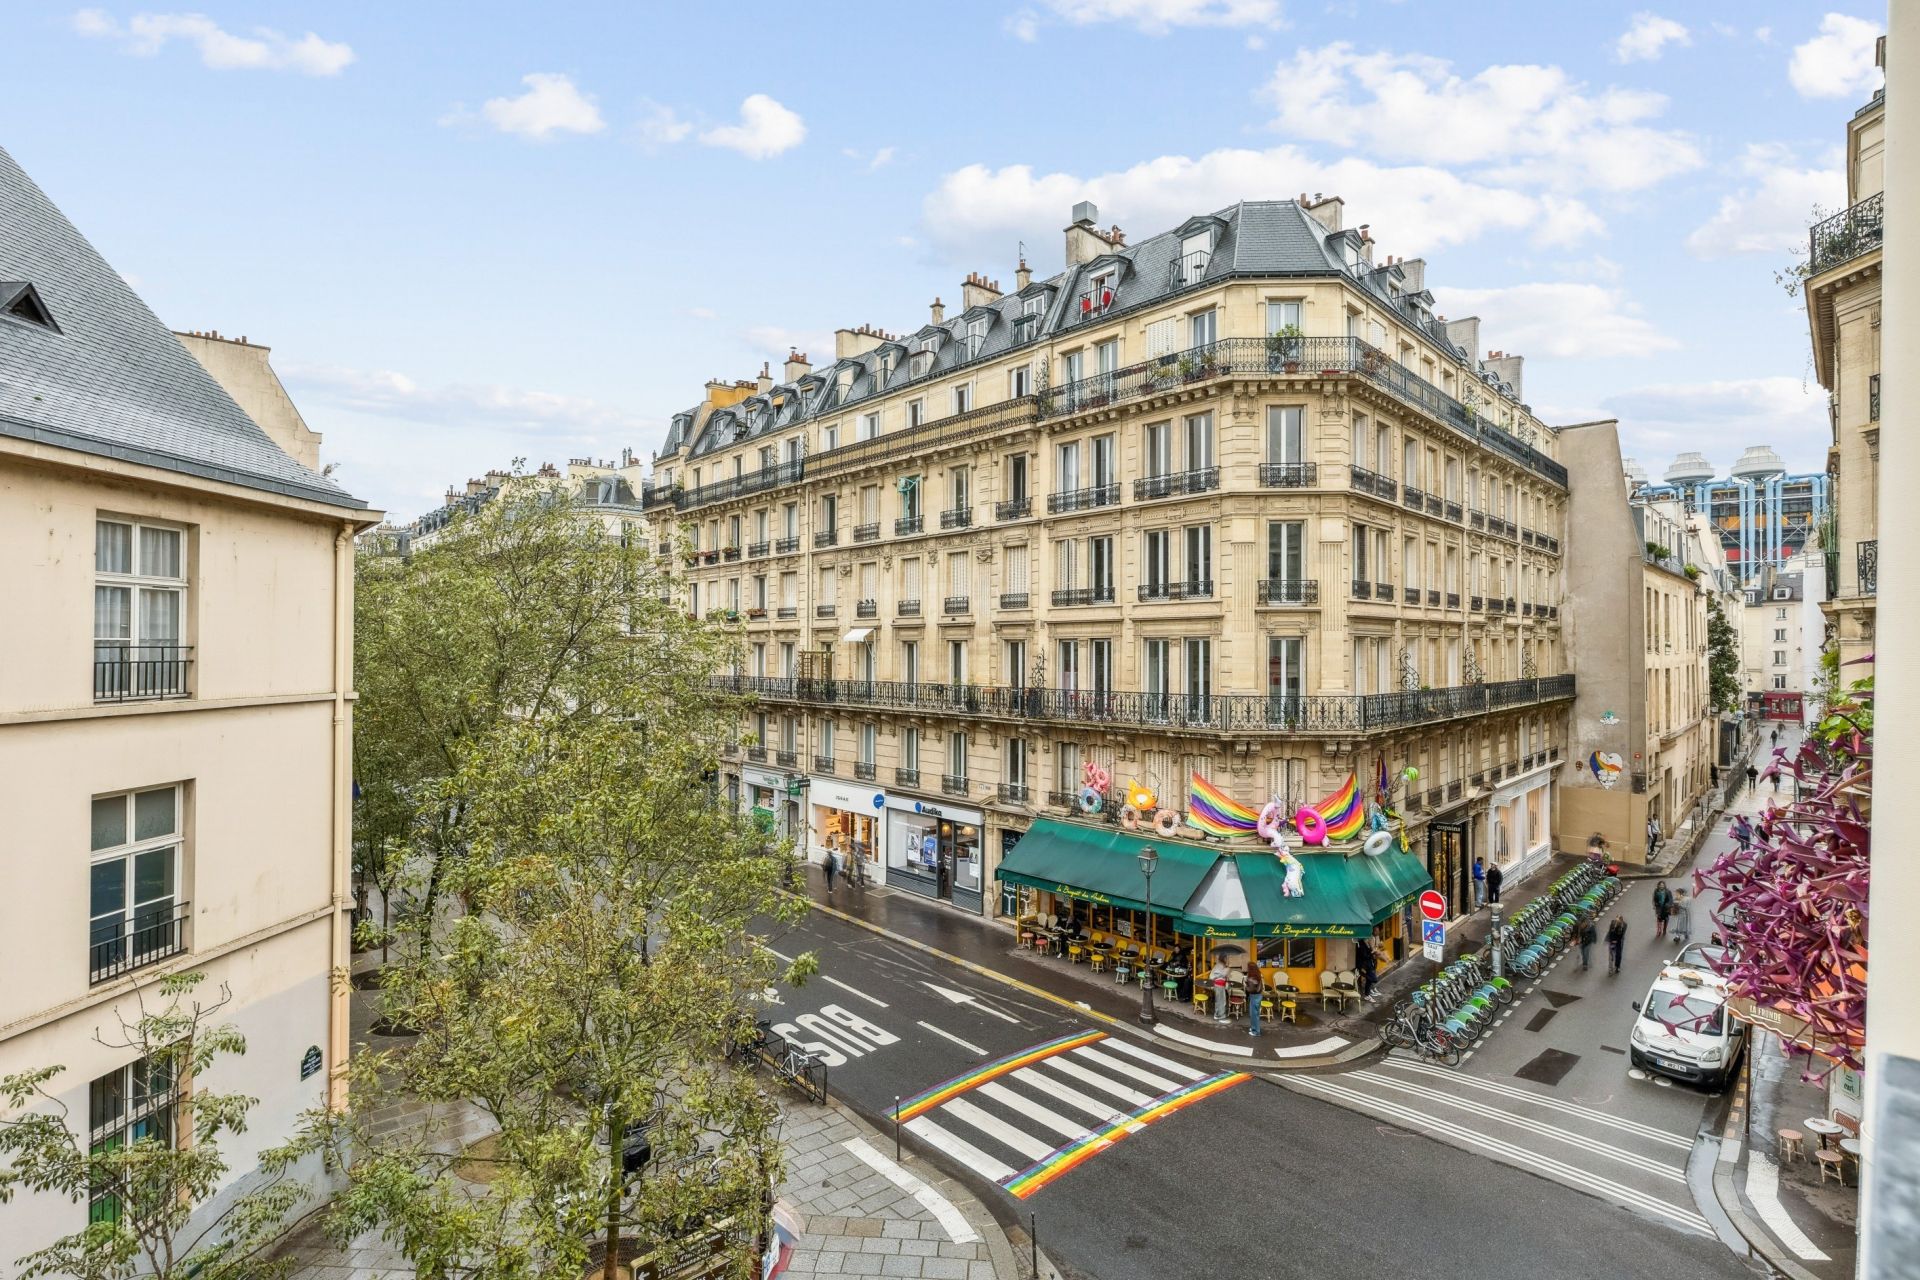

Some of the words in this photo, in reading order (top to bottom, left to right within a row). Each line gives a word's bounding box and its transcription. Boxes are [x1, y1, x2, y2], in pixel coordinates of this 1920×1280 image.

[922, 805, 943, 817] Audika
[1204, 926, 1238, 937] Brasserie
[1271, 924, 1281, 934] Le
[1281, 924, 1312, 937] Bouquet
[1311, 926, 1322, 934] des
[1325, 924, 1355, 935] Archives
[1749, 1004, 1757, 1014] LA
[770, 1003, 902, 1067] BUS
